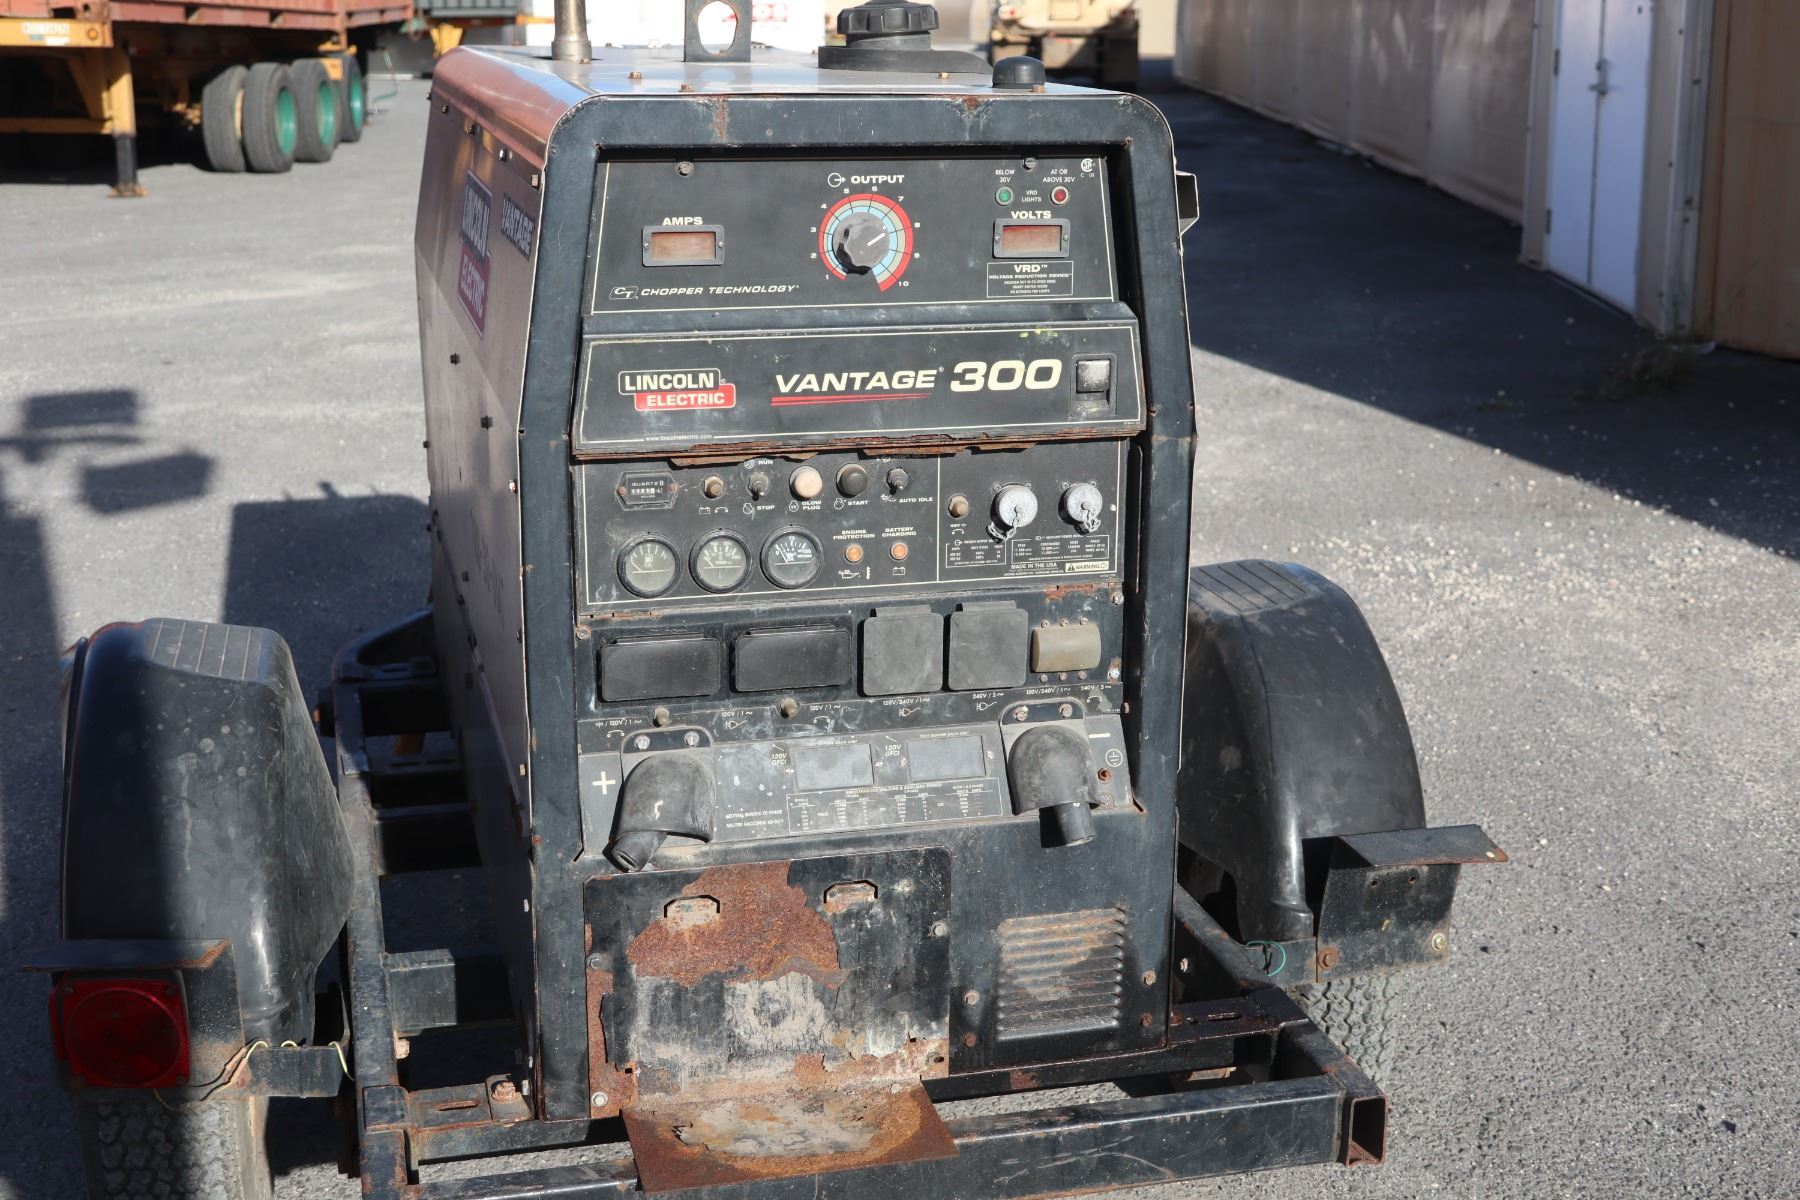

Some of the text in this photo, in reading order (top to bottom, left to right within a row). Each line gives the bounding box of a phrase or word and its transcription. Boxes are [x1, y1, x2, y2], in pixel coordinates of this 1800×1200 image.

[850, 174, 904, 184] OUTPUT
[462, 185, 490, 257] LINCOLN
[662, 216, 703, 226] AMPS
[1011, 210, 1052, 219] VOLTS
[502, 197, 534, 257] VANTAGE
[461, 256, 485, 318] ELECTRIC
[641, 288, 703, 296] CHOPPER
[709, 285, 796, 295] TECHNOLOGY
[625, 372, 714, 391] LINCOLN
[775, 358, 1062, 393] VANTAGE 300
[646, 392, 725, 407] ELECTRIC
